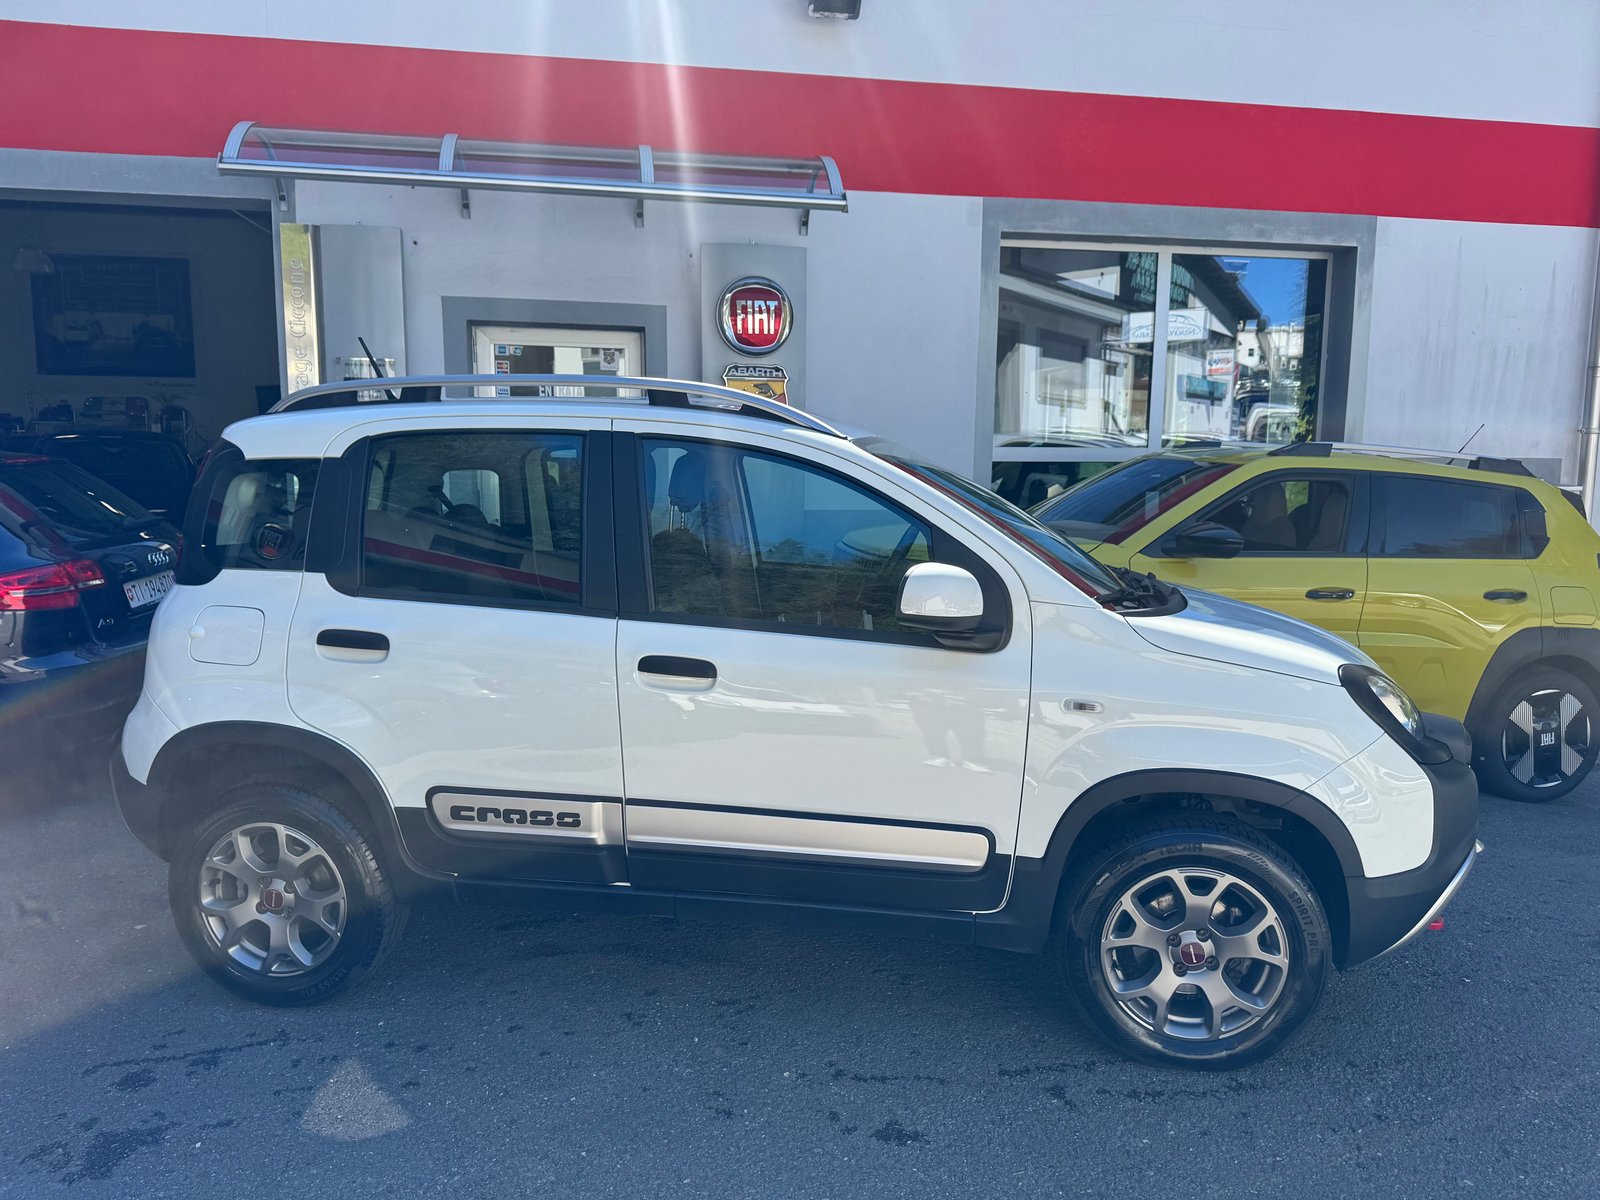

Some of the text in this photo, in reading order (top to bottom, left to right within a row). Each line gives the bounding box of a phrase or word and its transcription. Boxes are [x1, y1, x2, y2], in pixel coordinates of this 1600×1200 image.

[289, 258, 306, 338] Ciccone
[736, 300, 778, 334] FIAT
[728, 367, 782, 377] ABARTH
[1540, 732, 1555, 746] FIAT
[1288, 891, 1314, 927] SPIRIT
